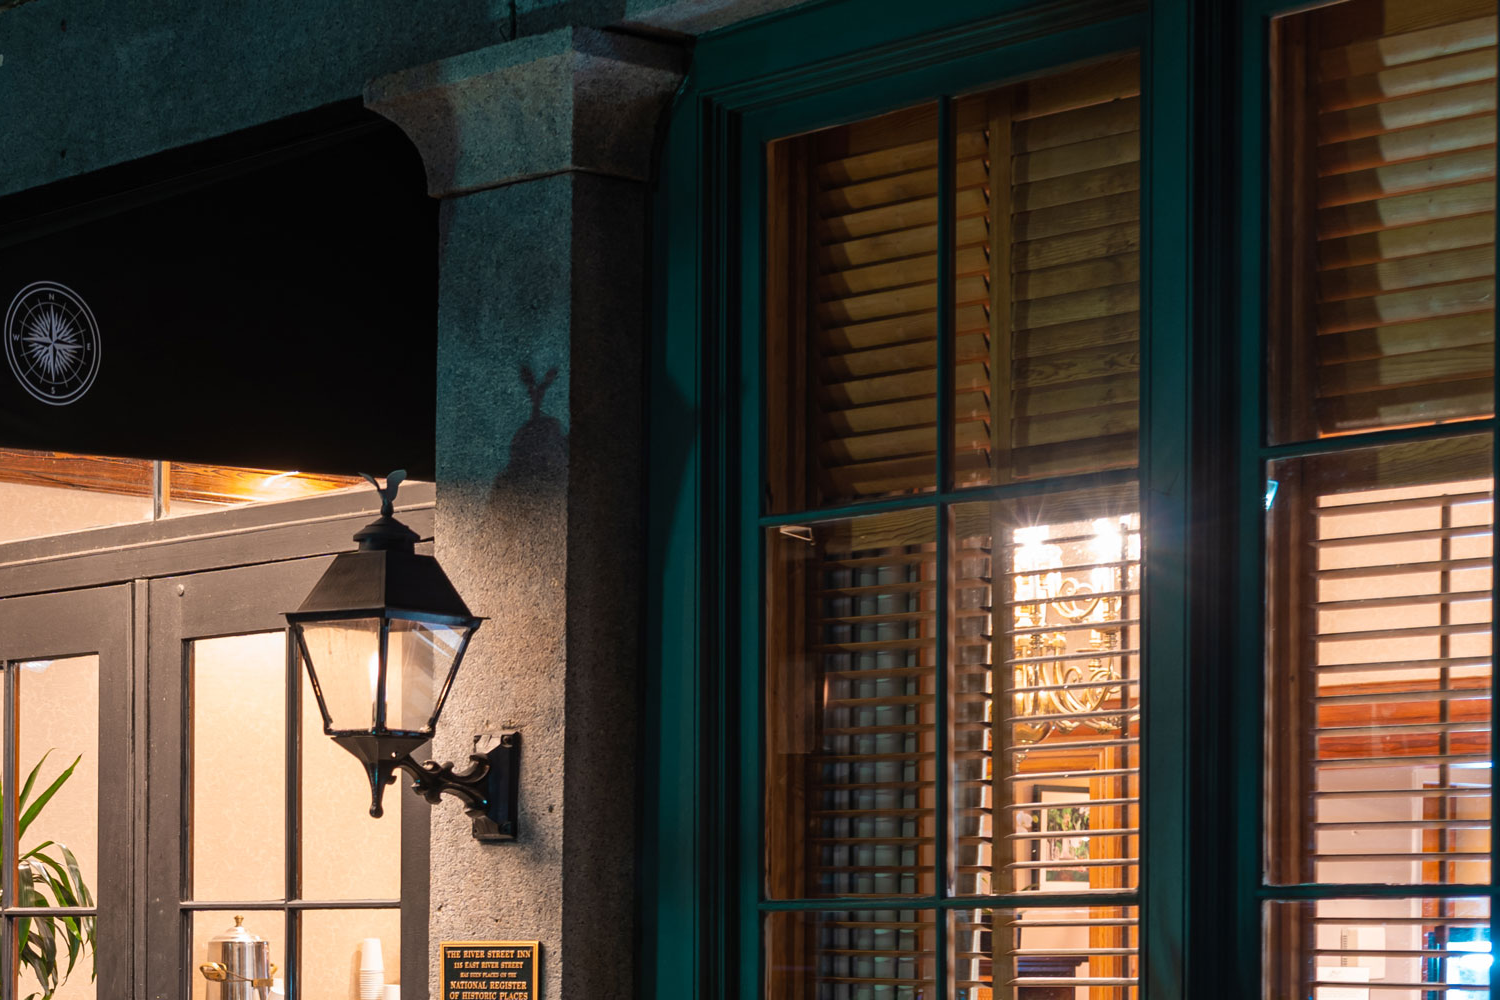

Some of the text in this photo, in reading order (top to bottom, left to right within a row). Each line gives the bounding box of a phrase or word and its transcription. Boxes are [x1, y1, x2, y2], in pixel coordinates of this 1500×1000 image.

[446, 950, 531, 958] THE RIVER STREET INN
[450, 981, 527, 989] NATIONAL REGISTER
[500, 992, 528, 1000] PLACES
